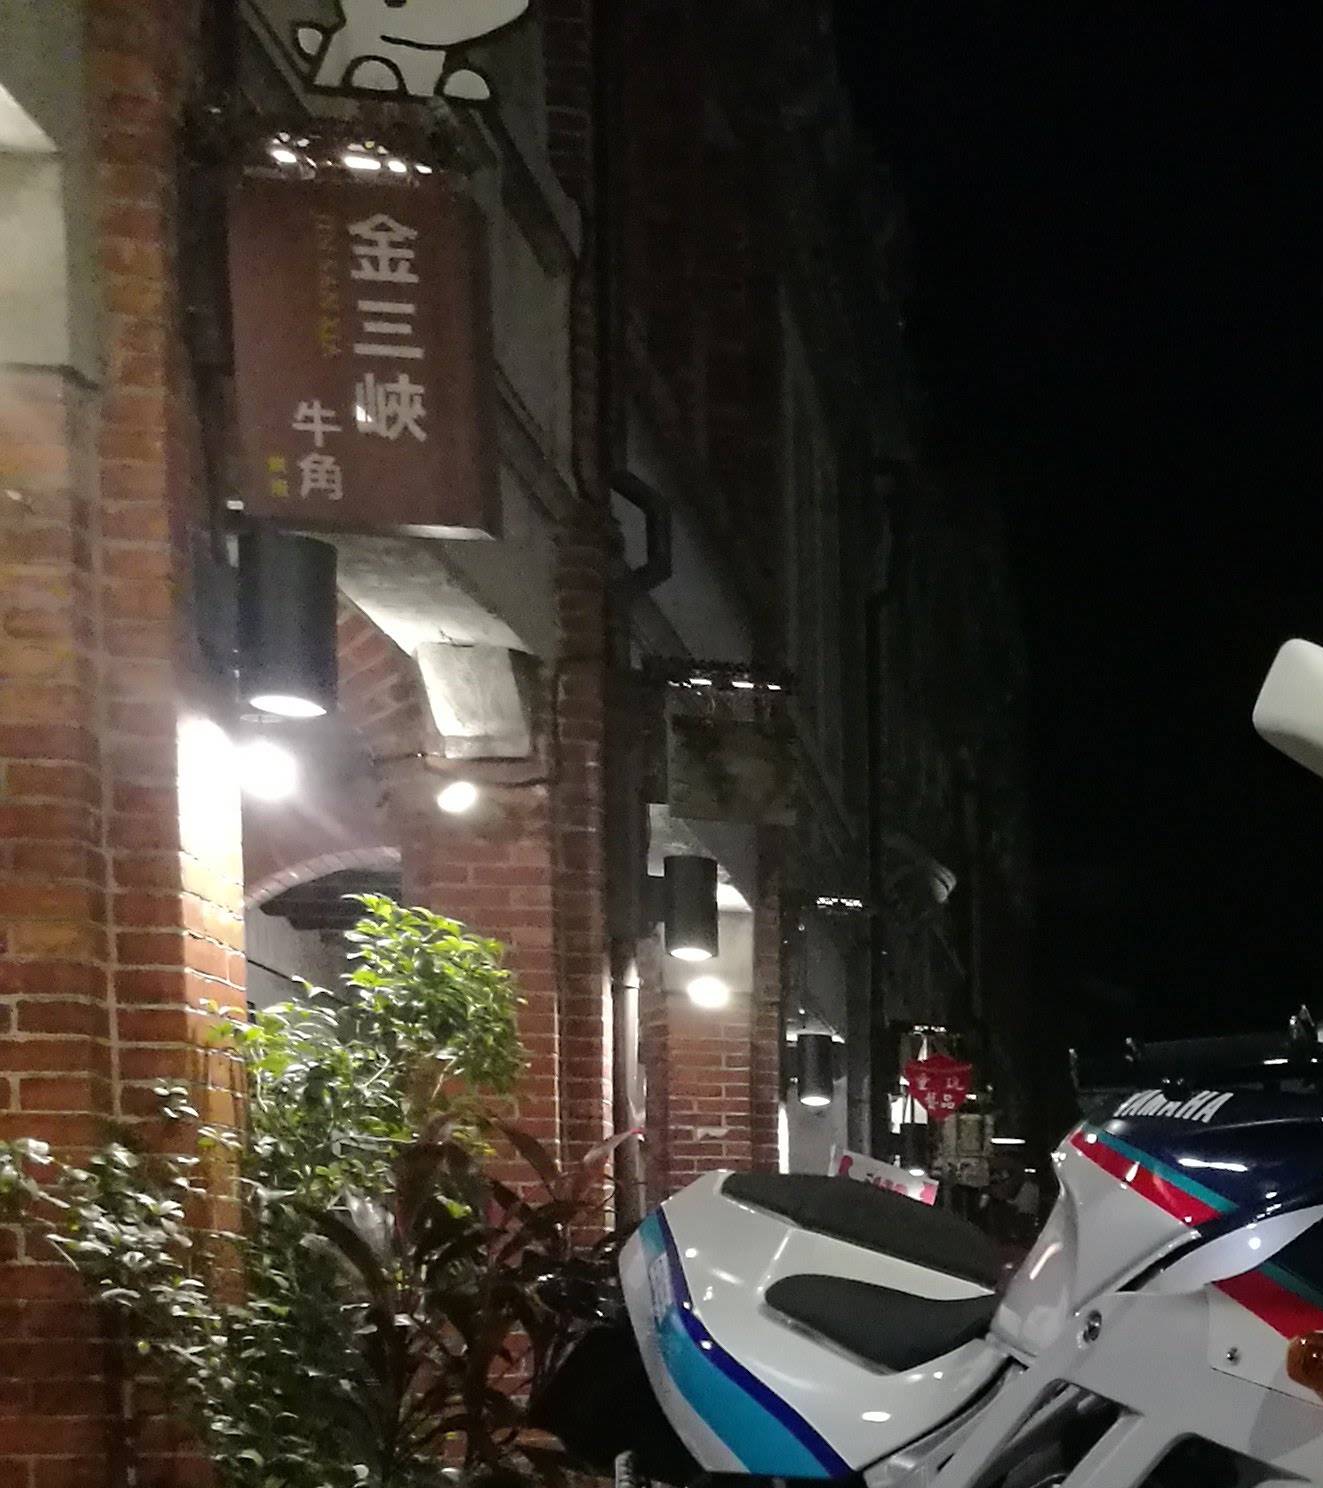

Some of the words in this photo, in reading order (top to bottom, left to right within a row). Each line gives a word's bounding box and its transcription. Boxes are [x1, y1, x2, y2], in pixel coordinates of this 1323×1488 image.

[347, 212, 429, 442] 金三峽
[291, 399, 344, 500] 牛角
